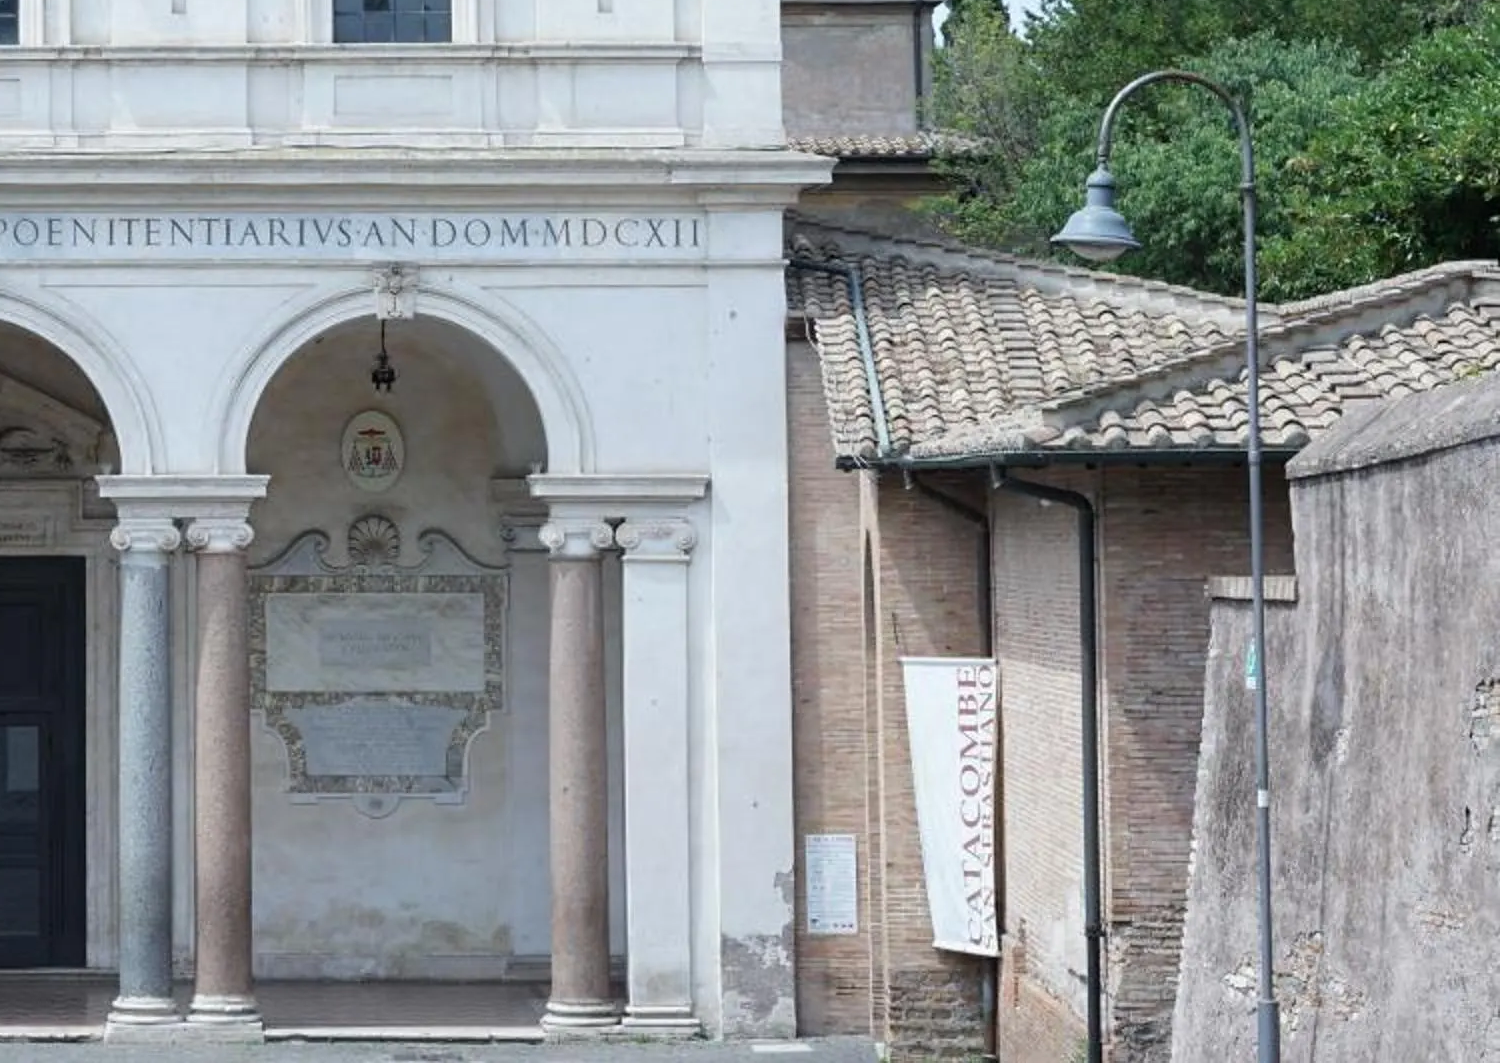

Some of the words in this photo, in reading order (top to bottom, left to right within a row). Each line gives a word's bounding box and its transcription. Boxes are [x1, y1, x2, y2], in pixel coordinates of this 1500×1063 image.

[363, 218, 416, 247] AN
[430, 218, 529, 248] DOM
[543, 218, 700, 248] MDCXII
[958, 666, 982, 945] CATACOMBE
[979, 665, 995, 868] SEBASTIANO
[981, 887, 996, 949] SAN
